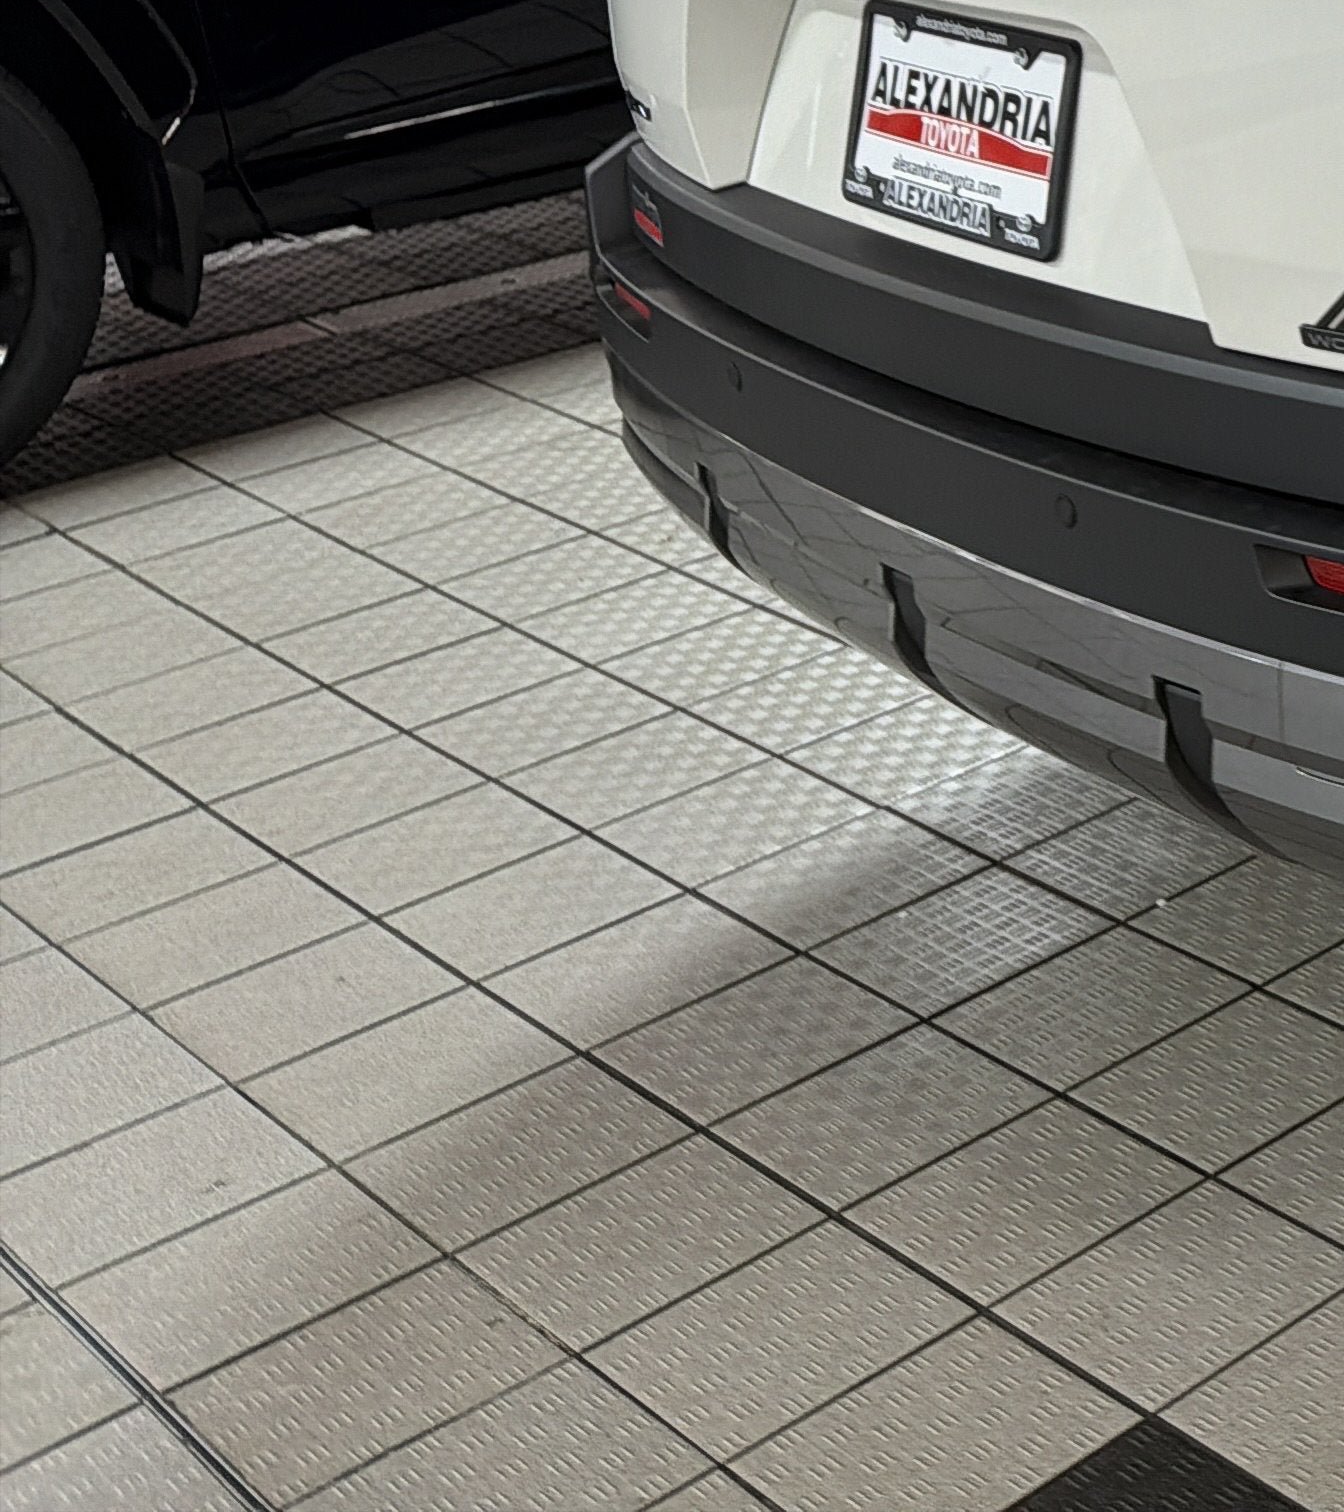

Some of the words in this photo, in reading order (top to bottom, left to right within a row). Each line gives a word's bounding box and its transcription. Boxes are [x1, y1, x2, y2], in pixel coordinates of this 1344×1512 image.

[871, 61, 1053, 147] ALEXANDRIA
[920, 117, 981, 159] TOYOTA
[883, 178, 991, 237] ALEXANDRIA
